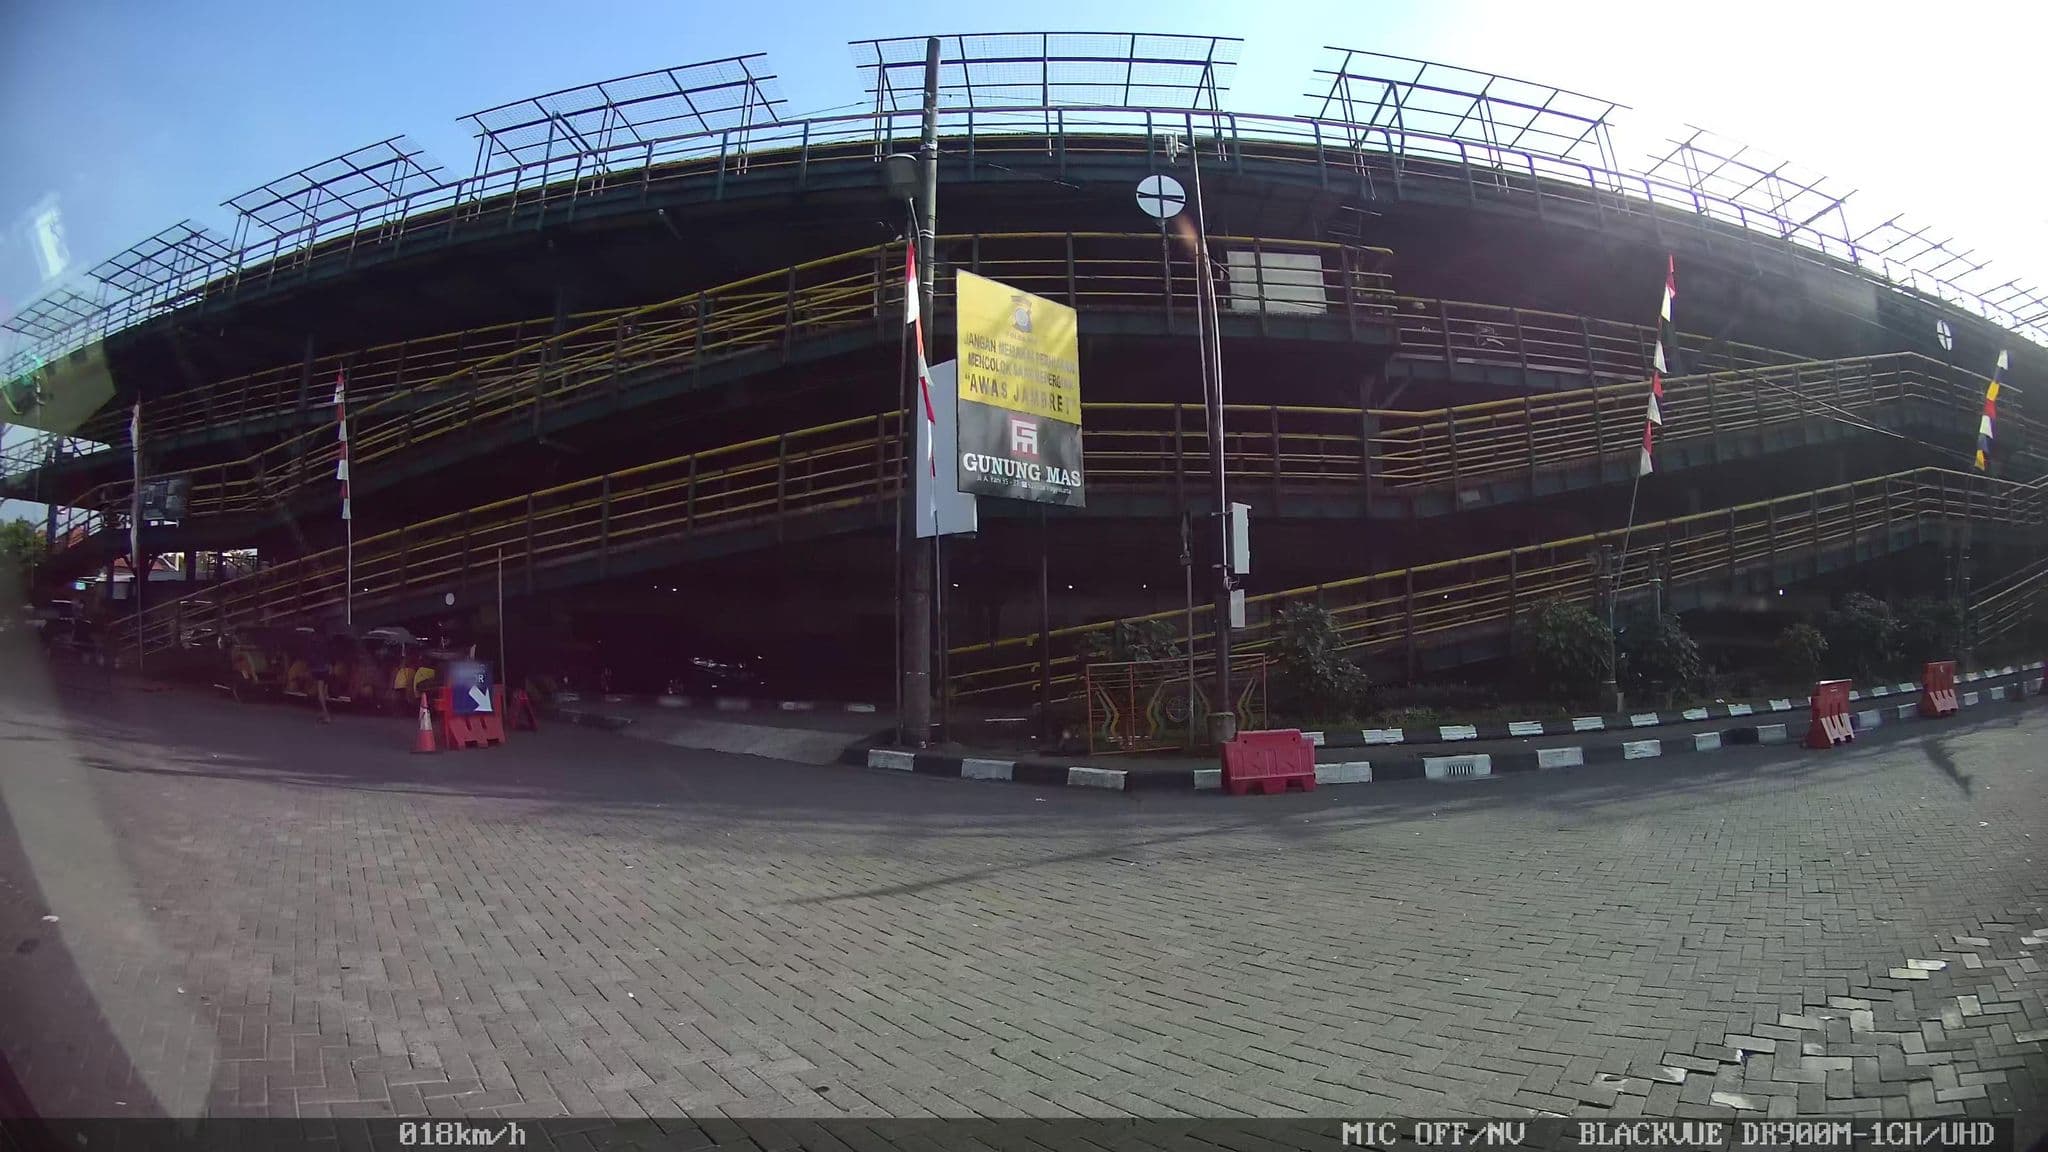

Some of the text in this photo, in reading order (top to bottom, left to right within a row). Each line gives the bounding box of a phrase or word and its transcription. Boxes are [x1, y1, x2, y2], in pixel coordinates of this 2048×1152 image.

[964, 332, 997, 353] JANGAN
[967, 352, 1012, 376] MENCOLOK
[963, 453, 1041, 481] GUNUNG
[1046, 466, 1081, 487] MAS
